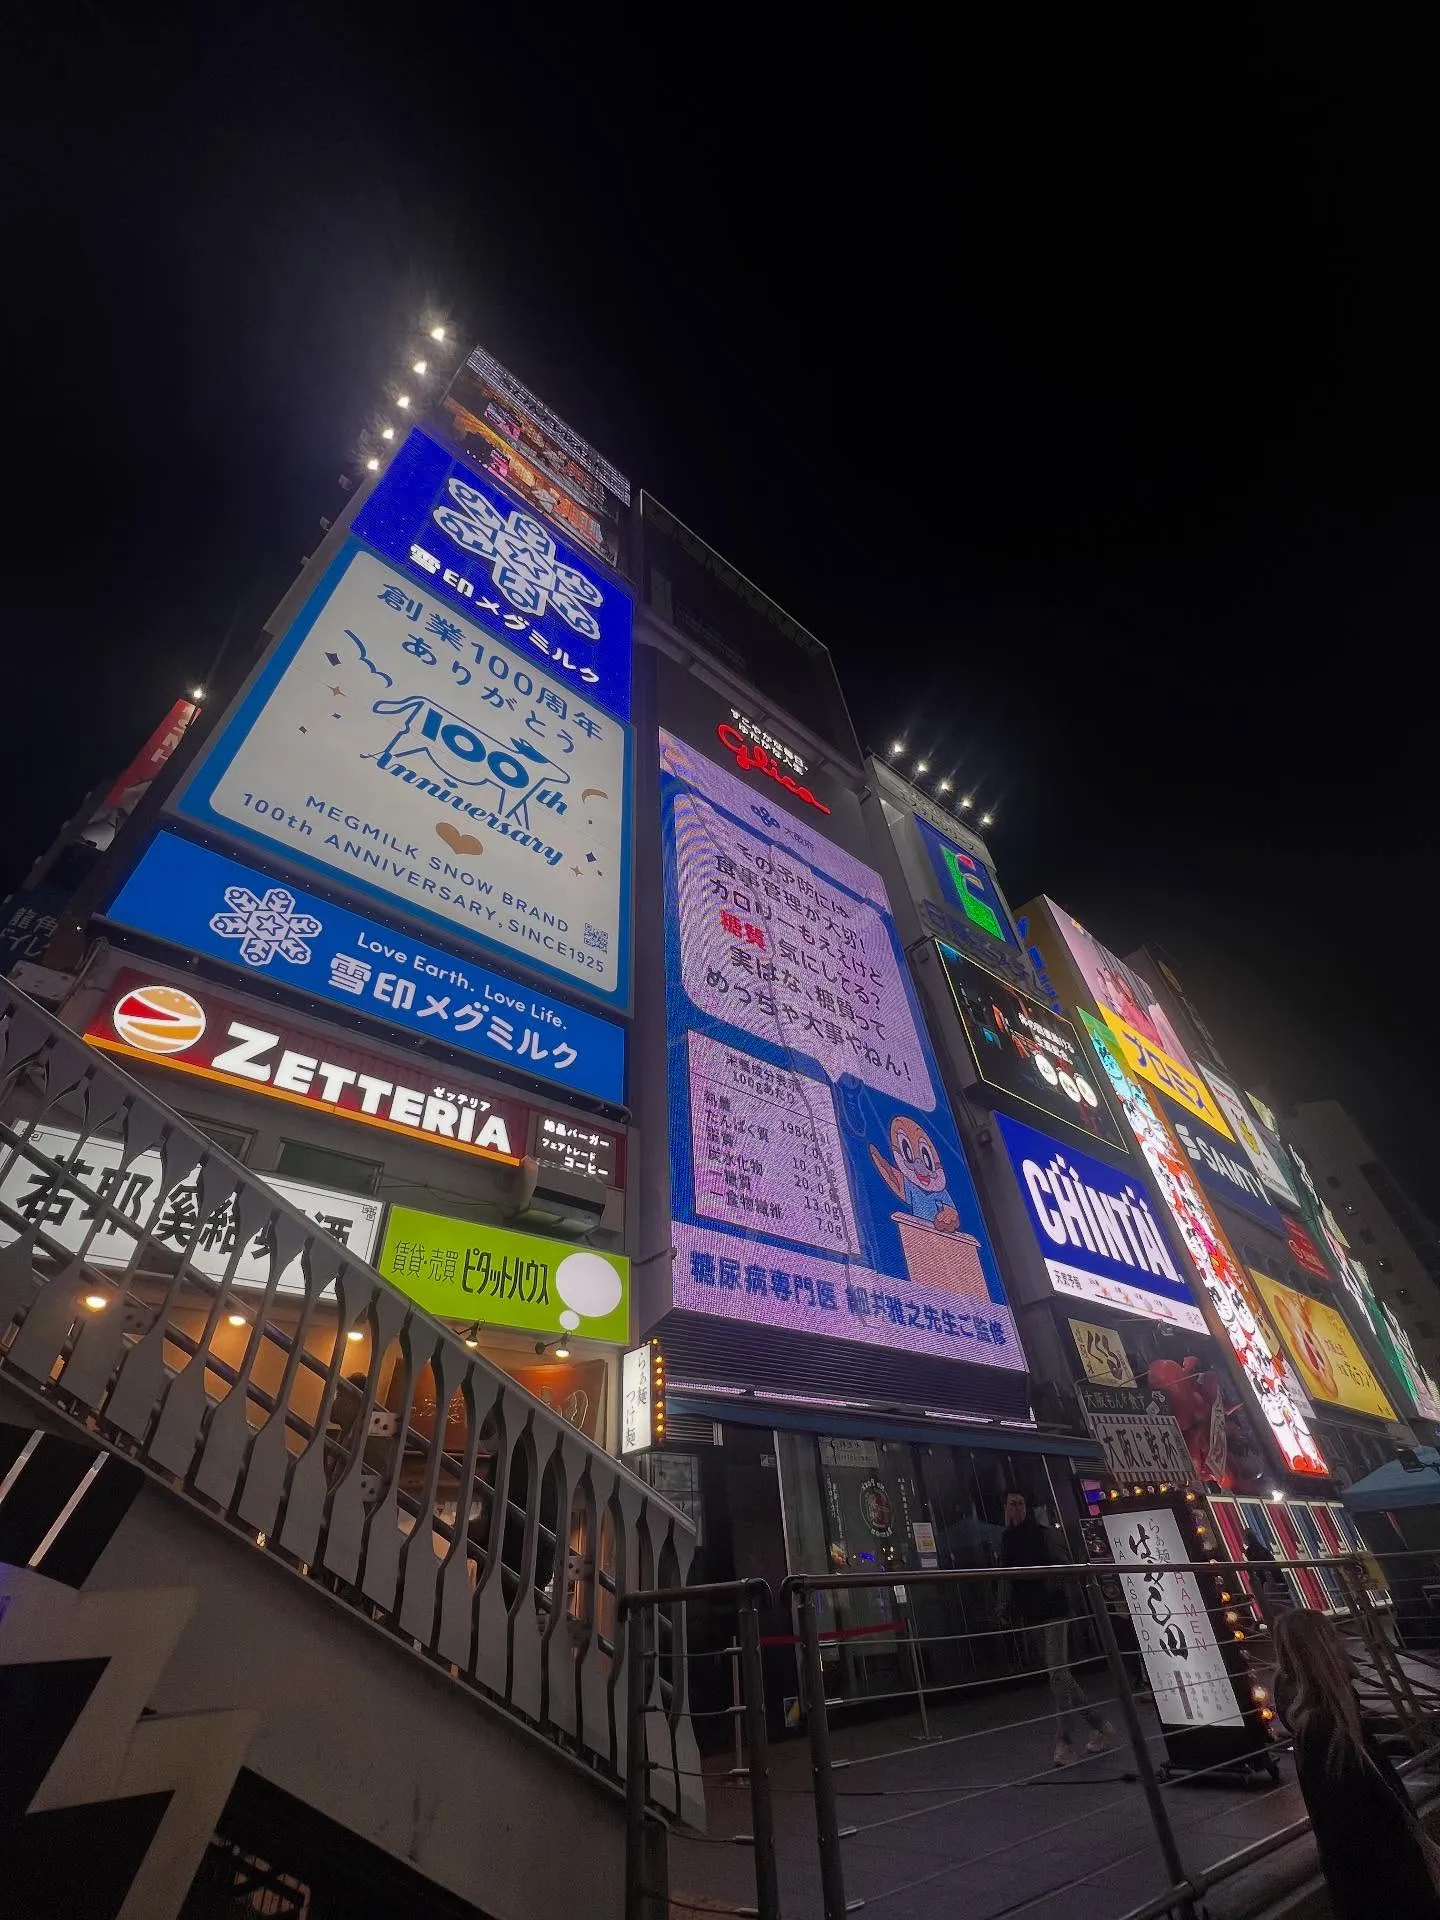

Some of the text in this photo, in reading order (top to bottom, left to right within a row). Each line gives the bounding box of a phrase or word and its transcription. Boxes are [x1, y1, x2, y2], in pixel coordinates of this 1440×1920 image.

[410, 543, 600, 683] 雪印メグミルク
[377, 582, 605, 741] 創業100周年
[401, 634, 577, 754] ありがとう
[242, 793, 313, 835] 100th
[360, 750, 563, 866] Anniversary
[718, 723, 832, 815] Glico
[305, 796, 569, 933] MEGMILK SNOW BRAND
[736, 842, 850, 918] その予防には
[329, 951, 579, 1070] 雪印メグミルク
[357, 932, 569, 1030] Love Earth. Love Life.
[211, 1022, 512, 1155] ZETTERIA
[433, 1086, 491, 1112] ゼッテリア
[543, 1119, 610, 1147] 絶品バーガー
[541, 1137, 597, 1161] フェアトレード
[564, 1156, 609, 1176] コーヒー
[1195, 1136, 1273, 1207] SAMTY
[1022, 1154, 1181, 1284] CHINTAI
[461, 1248, 549, 1306] ピタットハウス
[625, 1390, 636, 1447] つけ麺
[1114, 1537, 1156, 1656] HAASHIDA
[1173, 1571, 1208, 1653] RAMEN
